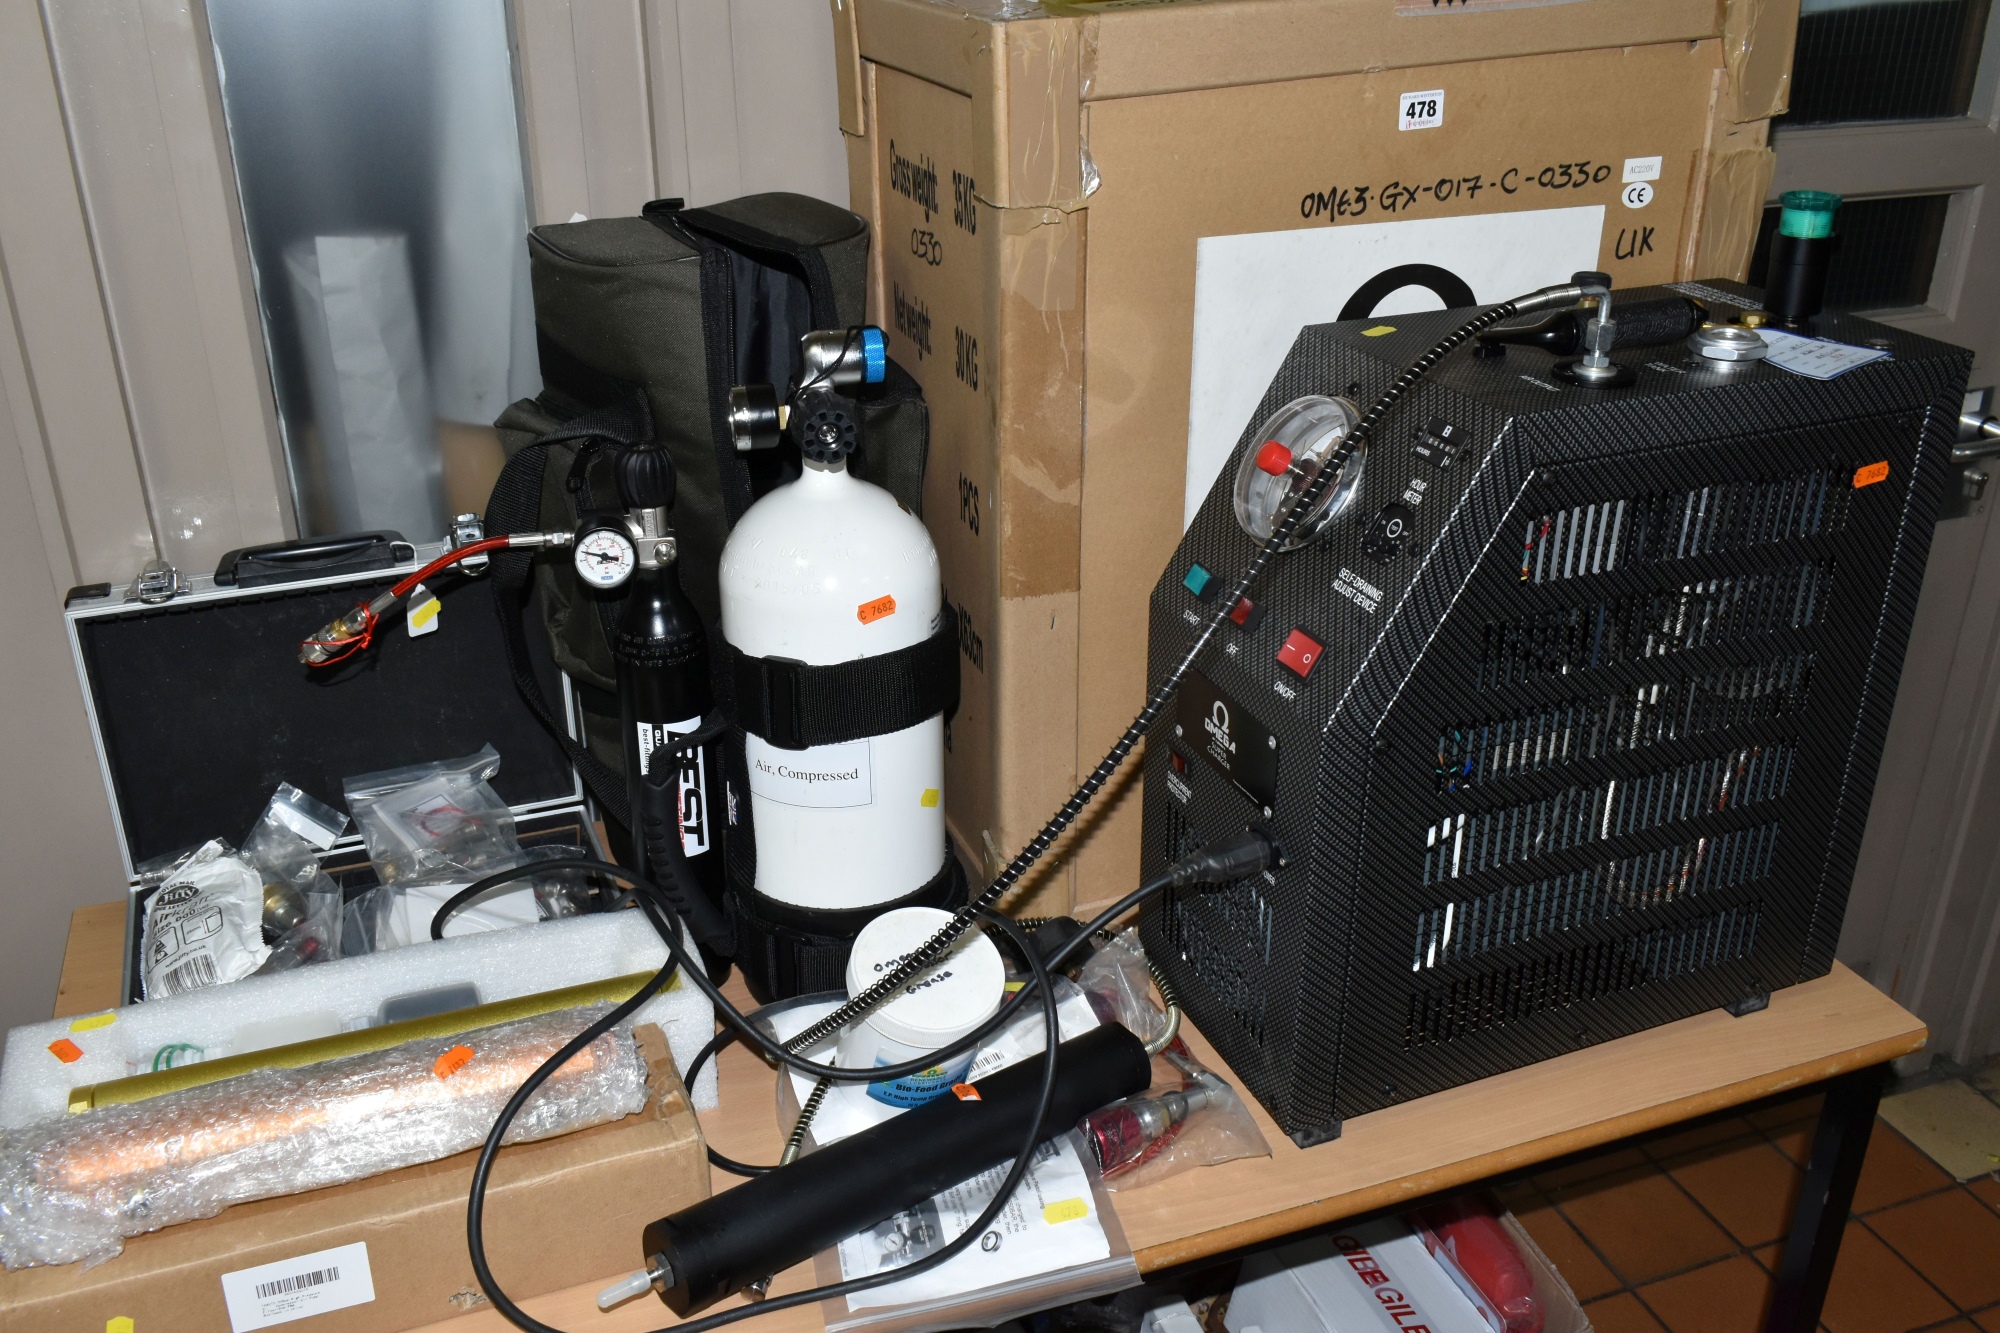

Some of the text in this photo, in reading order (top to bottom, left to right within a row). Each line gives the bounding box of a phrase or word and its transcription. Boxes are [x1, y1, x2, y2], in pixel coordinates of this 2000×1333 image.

[1406, 99, 1437, 119] 478
[1629, 163, 1655, 175] AC220V
[911, 228, 942, 266] 0330
[1615, 226, 1655, 259] UK
[955, 325, 978, 392] 30KG
[1415, 445, 1431, 457] HOURS
[1866, 466, 1886, 480] 7682
[1409, 478, 1427, 493] HOUR
[958, 472, 980, 536] 1PCS
[1402, 489, 1422, 506] METER
[1338, 567, 1383, 602] SELF-DRAINING
[1331, 578, 1378, 614] ADJUST DEVICE
[860, 600, 894, 620] C 7682
[1182, 609, 1200, 626] START
[1225, 642, 1239, 656] OFF
[1273, 680, 1296, 701] ON/OFF
[1204, 717, 1236, 755] OMEGA
[1206, 745, 1230, 771] CHARGER
[1211, 741, 1227, 760] SUPER
[755, 758, 859, 784] Air, Compressed
[158, 884, 196, 907] Jiffy
[895, 1082, 938, 1094] Bio-Food
[938, 1073, 963, 1090] Grade
[893, 1094, 909, 1102] High
[1015, 1202, 1026, 1223] charged
[1004, 1221, 1013, 1235] then
[1013, 1223, 1021, 1233] the
